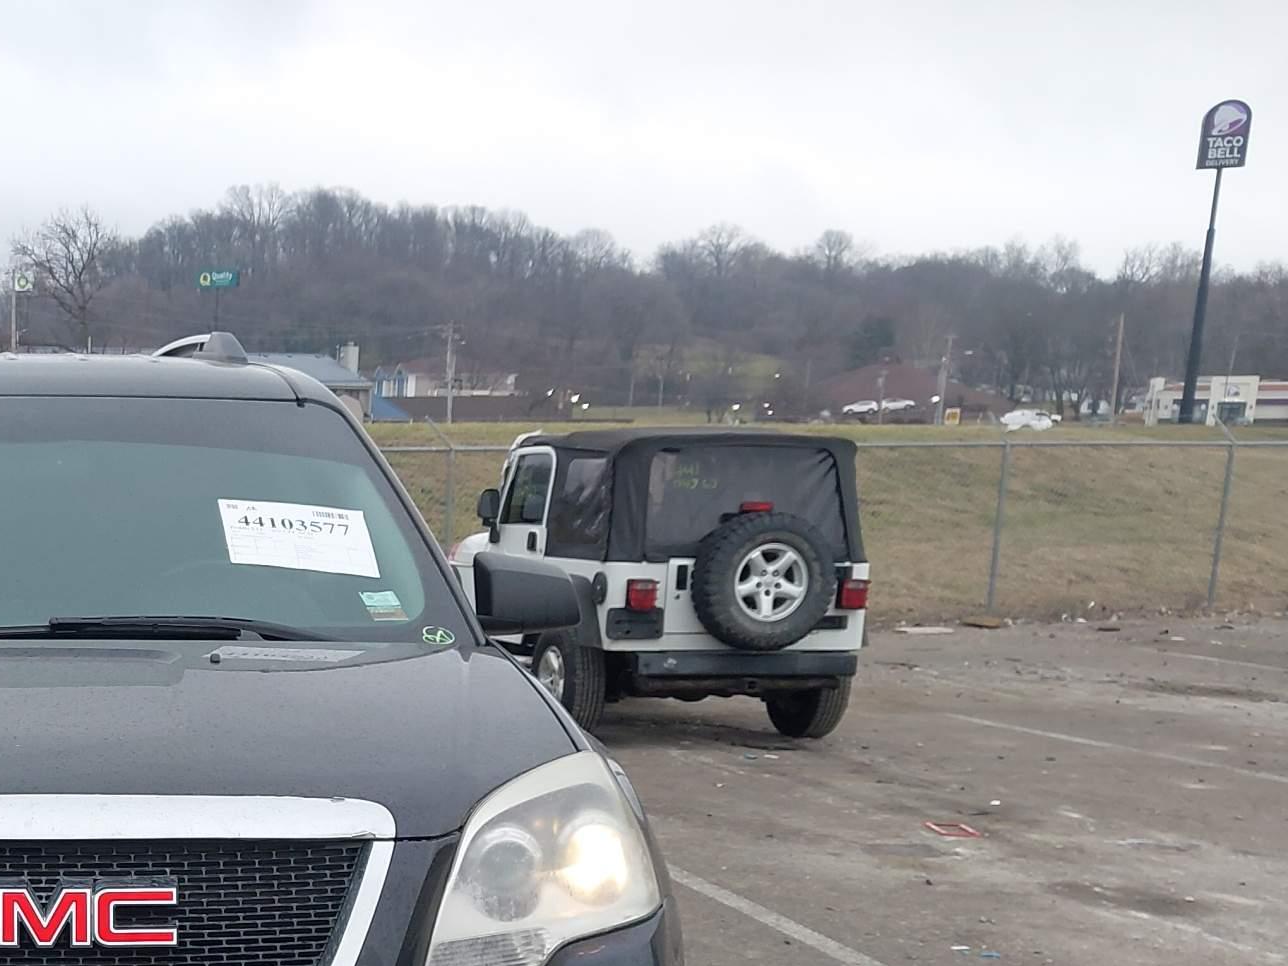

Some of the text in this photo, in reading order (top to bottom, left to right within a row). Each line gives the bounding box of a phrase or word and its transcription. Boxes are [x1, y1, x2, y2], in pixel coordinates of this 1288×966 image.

[1207, 136, 1243, 147] TACO
[1208, 147, 1240, 158] BELL
[238, 515, 349, 535] 44103577
